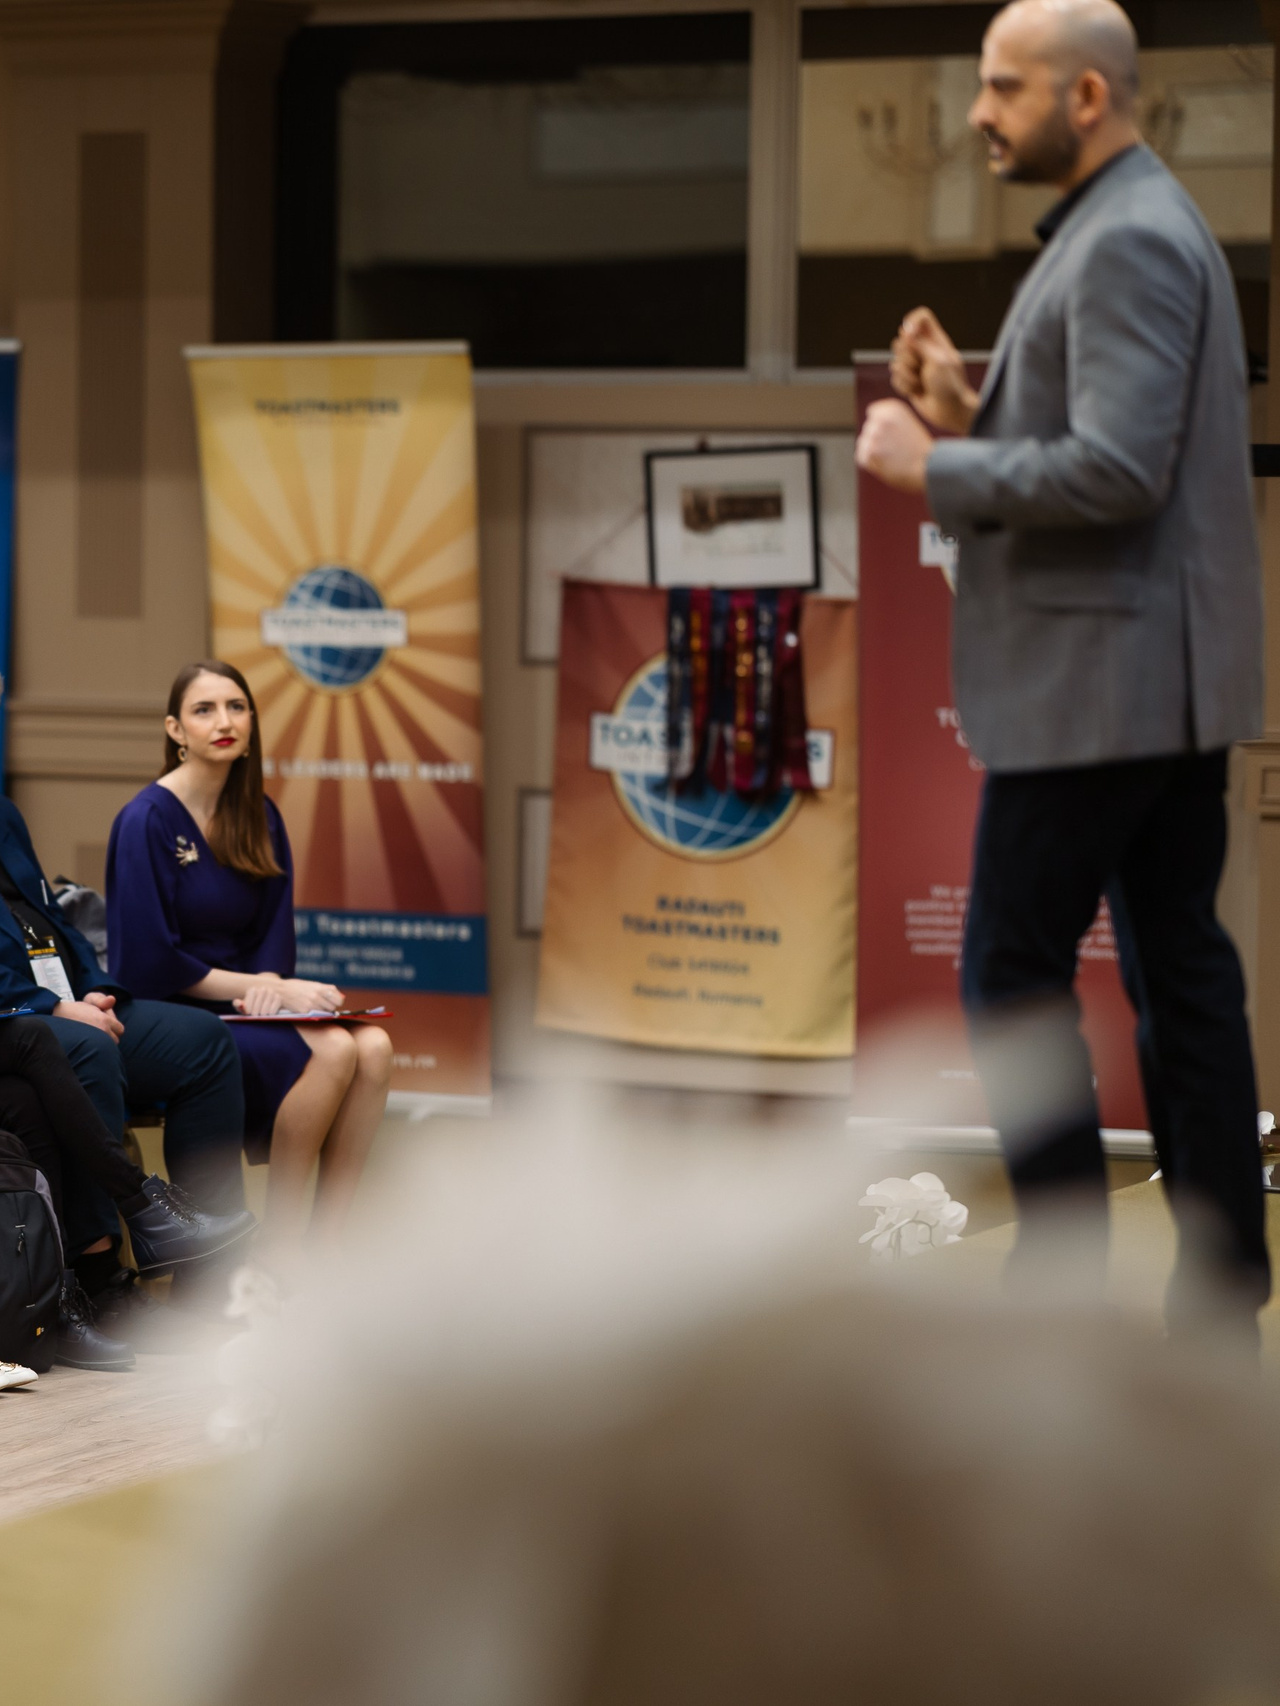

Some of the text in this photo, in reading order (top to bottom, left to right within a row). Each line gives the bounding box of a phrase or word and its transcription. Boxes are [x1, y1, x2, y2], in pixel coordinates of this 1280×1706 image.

[373, 761, 411, 780] ARE
[316, 914, 472, 941] Toastmasters
[622, 914, 781, 947] TOASTMASTERS
